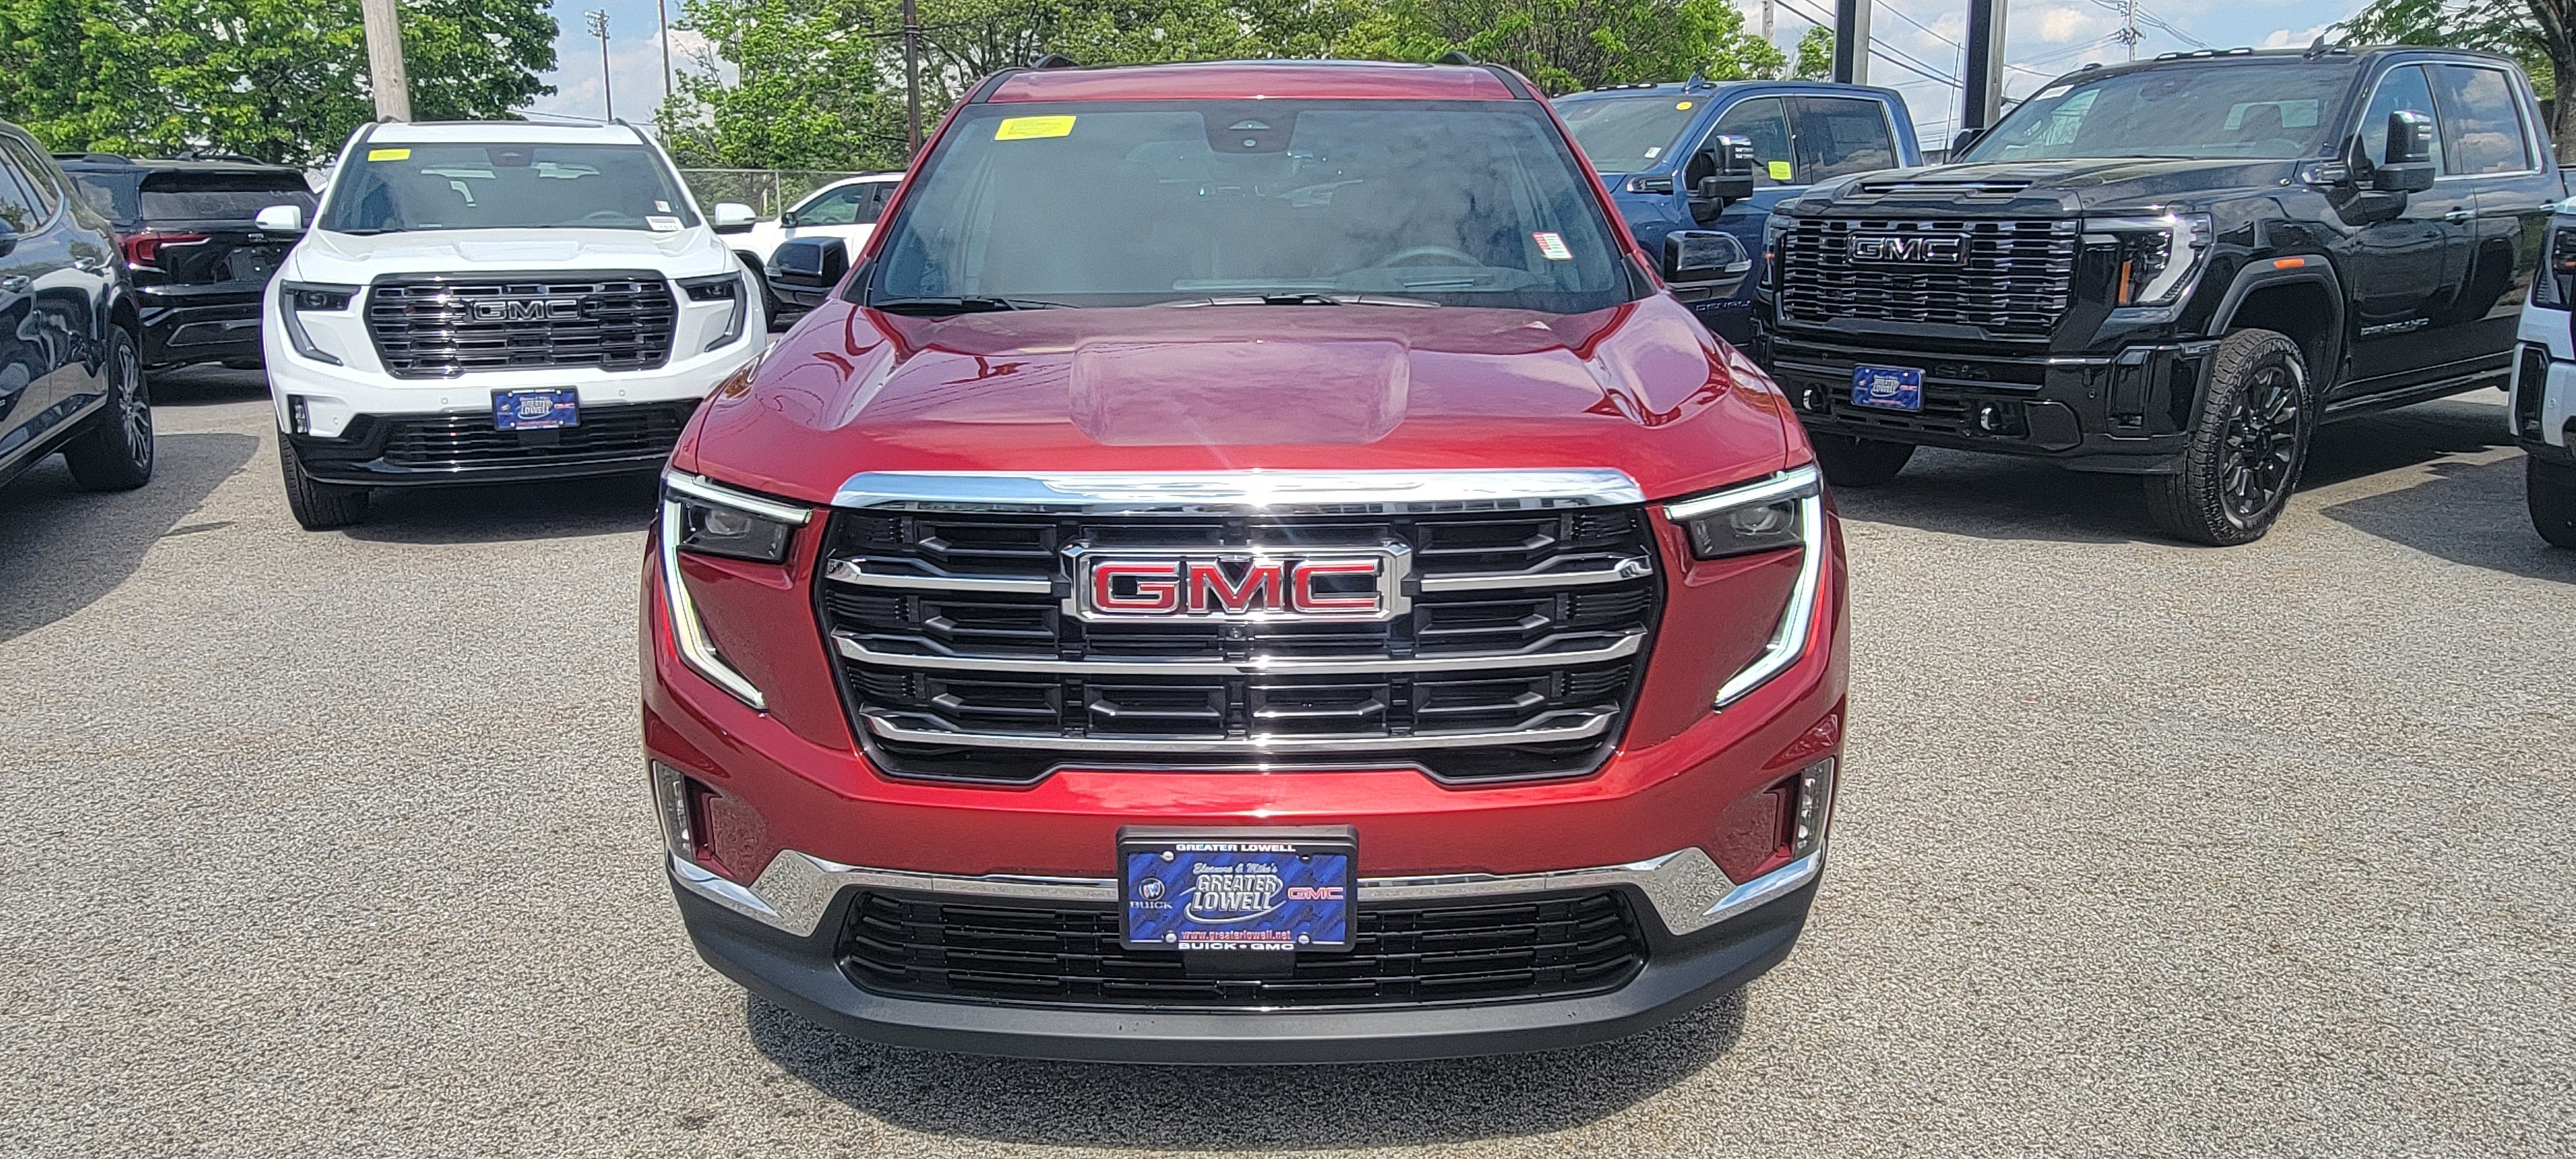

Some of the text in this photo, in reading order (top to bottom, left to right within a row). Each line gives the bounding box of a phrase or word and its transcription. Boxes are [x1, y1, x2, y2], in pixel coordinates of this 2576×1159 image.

[1853, 236, 1960, 261] GMC
[473, 299, 578, 320] GMC
[1092, 559, 1381, 614] GMC
[1196, 874, 1278, 892] GREATER
[1191, 892, 1273, 911] LOWELL
[1288, 887, 1343, 900] GMC
[1181, 930, 1291, 941] www.greaterlowell.net
